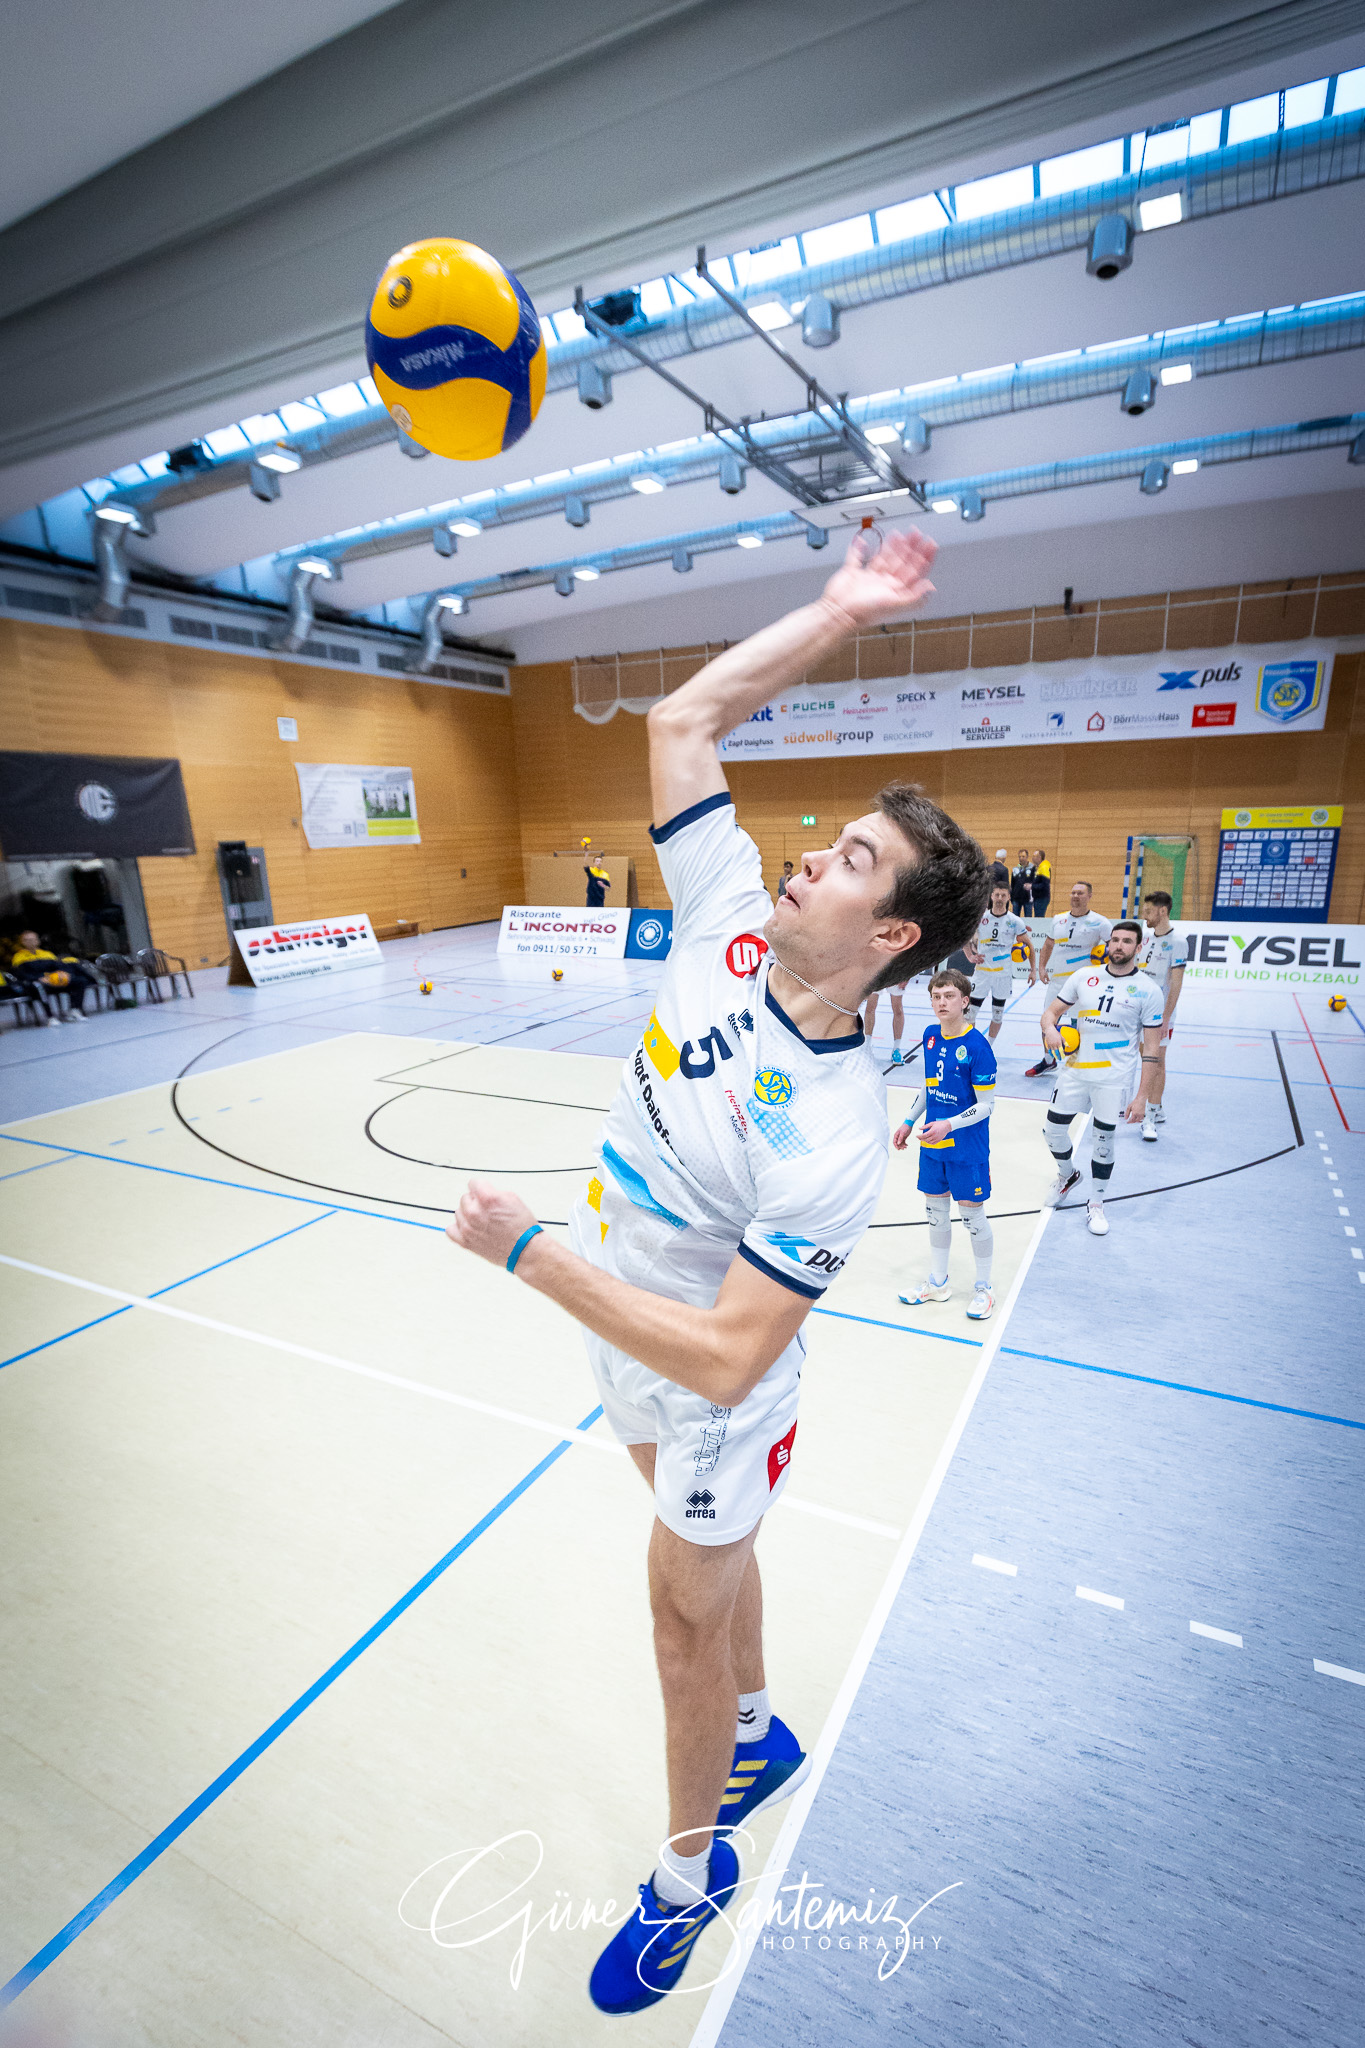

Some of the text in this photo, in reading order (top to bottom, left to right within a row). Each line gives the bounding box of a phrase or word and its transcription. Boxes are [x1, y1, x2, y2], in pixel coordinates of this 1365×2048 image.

[399, 340, 465, 372] MIKASA
[1200, 662, 1242, 688] puls
[896, 692, 926, 702] SPECK
[961, 685, 1025, 701] MEYSEL
[792, 700, 835, 711] FUCHS
[843, 705, 888, 715] Heinzelmann
[745, 706, 774, 722] xit
[966, 732, 1006, 741] SERVICES
[510, 909, 562, 919] Ristorante
[597, 911, 618, 921] Gino
[248, 924, 368, 957] schweiger
[991, 928, 999, 939] 9
[1068, 928, 1075, 939] 1
[517, 943, 597, 955] fon 0911/50 57 71
[1145, 950, 1153, 964] 6
[1183, 967, 1360, 985] MEREI UND HOLZBAU
[1097, 994, 1114, 1013] 11
[679, 1026, 734, 1080] 5
[935, 1059, 944, 1081] 3
[724, 1089, 748, 1135] Heinze
[729, 1115, 747, 1143] Medien
[693, 1401, 729, 1477] HÜTTING
